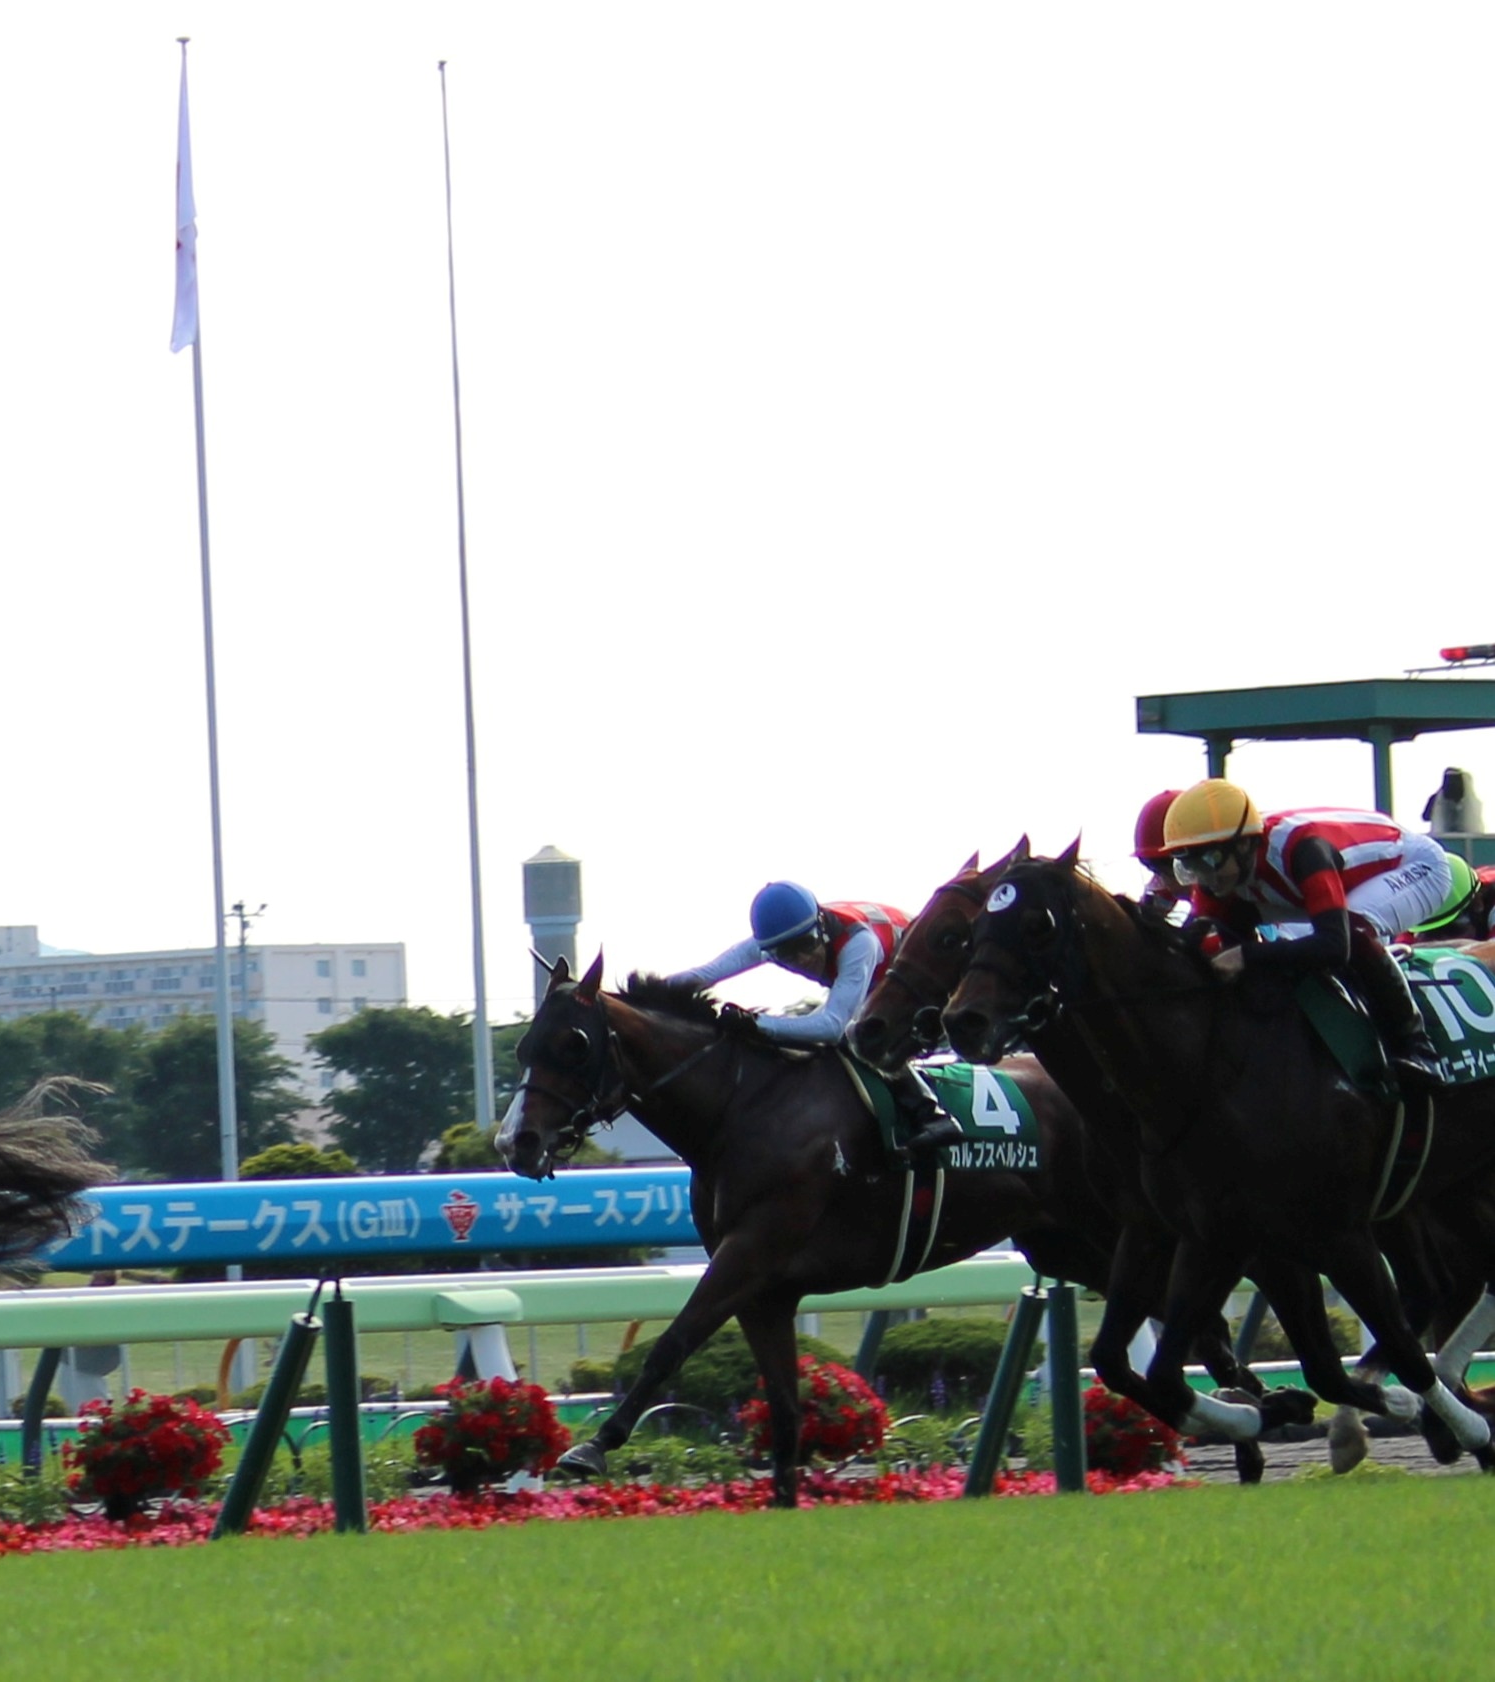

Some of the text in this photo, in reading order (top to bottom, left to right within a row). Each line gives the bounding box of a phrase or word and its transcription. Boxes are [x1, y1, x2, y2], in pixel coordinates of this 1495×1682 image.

[1405, 956, 1495, 1042] 10
[971, 1065, 1021, 1135] 4
[948, 1141, 1038, 1168] カルプスペルシュ
[493, 1184, 694, 1233] サマースプリ
